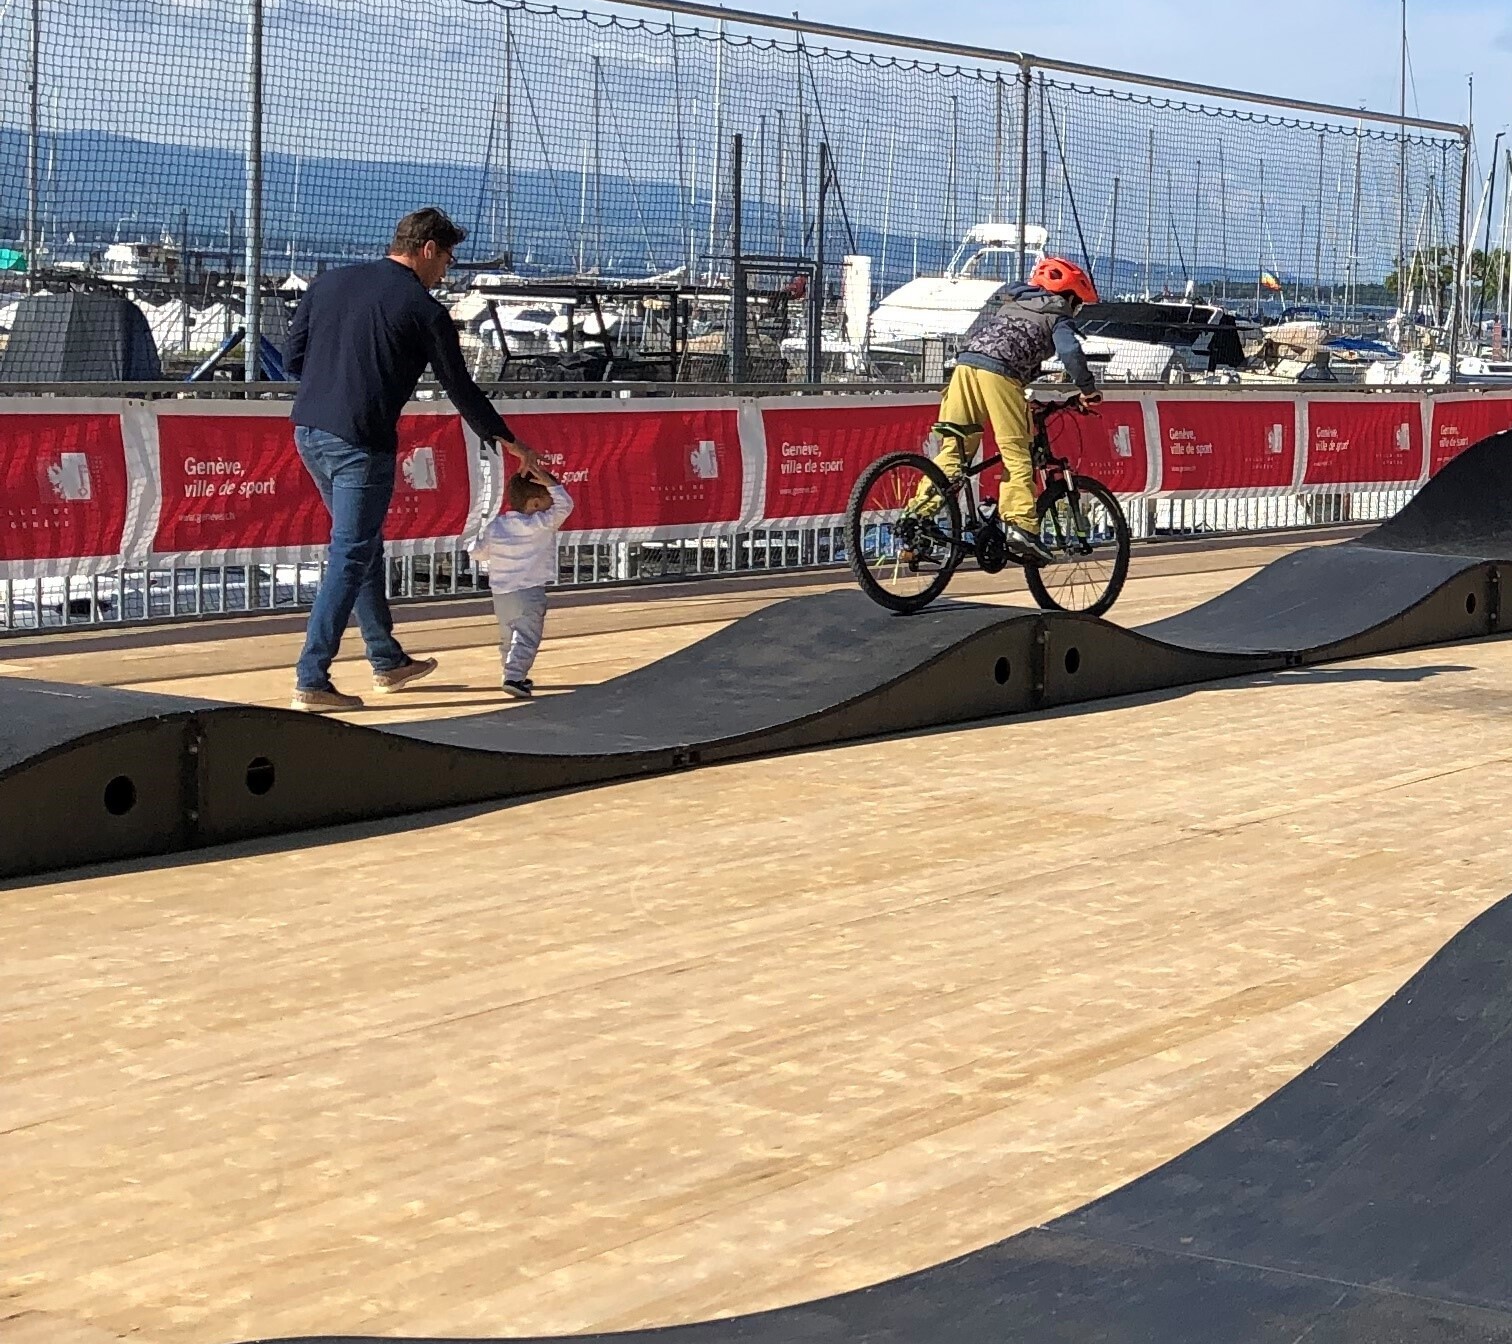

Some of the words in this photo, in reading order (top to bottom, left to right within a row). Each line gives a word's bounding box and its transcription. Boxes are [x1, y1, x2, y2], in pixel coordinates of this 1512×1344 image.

[781, 441, 822, 457] Genève,
[1185, 443, 1195, 455] de
[184, 456, 245, 477] Genève,
[781, 459, 803, 474] ville
[804, 460, 818, 473] de
[819, 458, 844, 475] sport
[561, 467, 588, 485] sport
[184, 479, 215, 498] ville
[218, 479, 236, 496] de
[238, 477, 276, 498] sport
[8, 508, 37, 516] LLE
